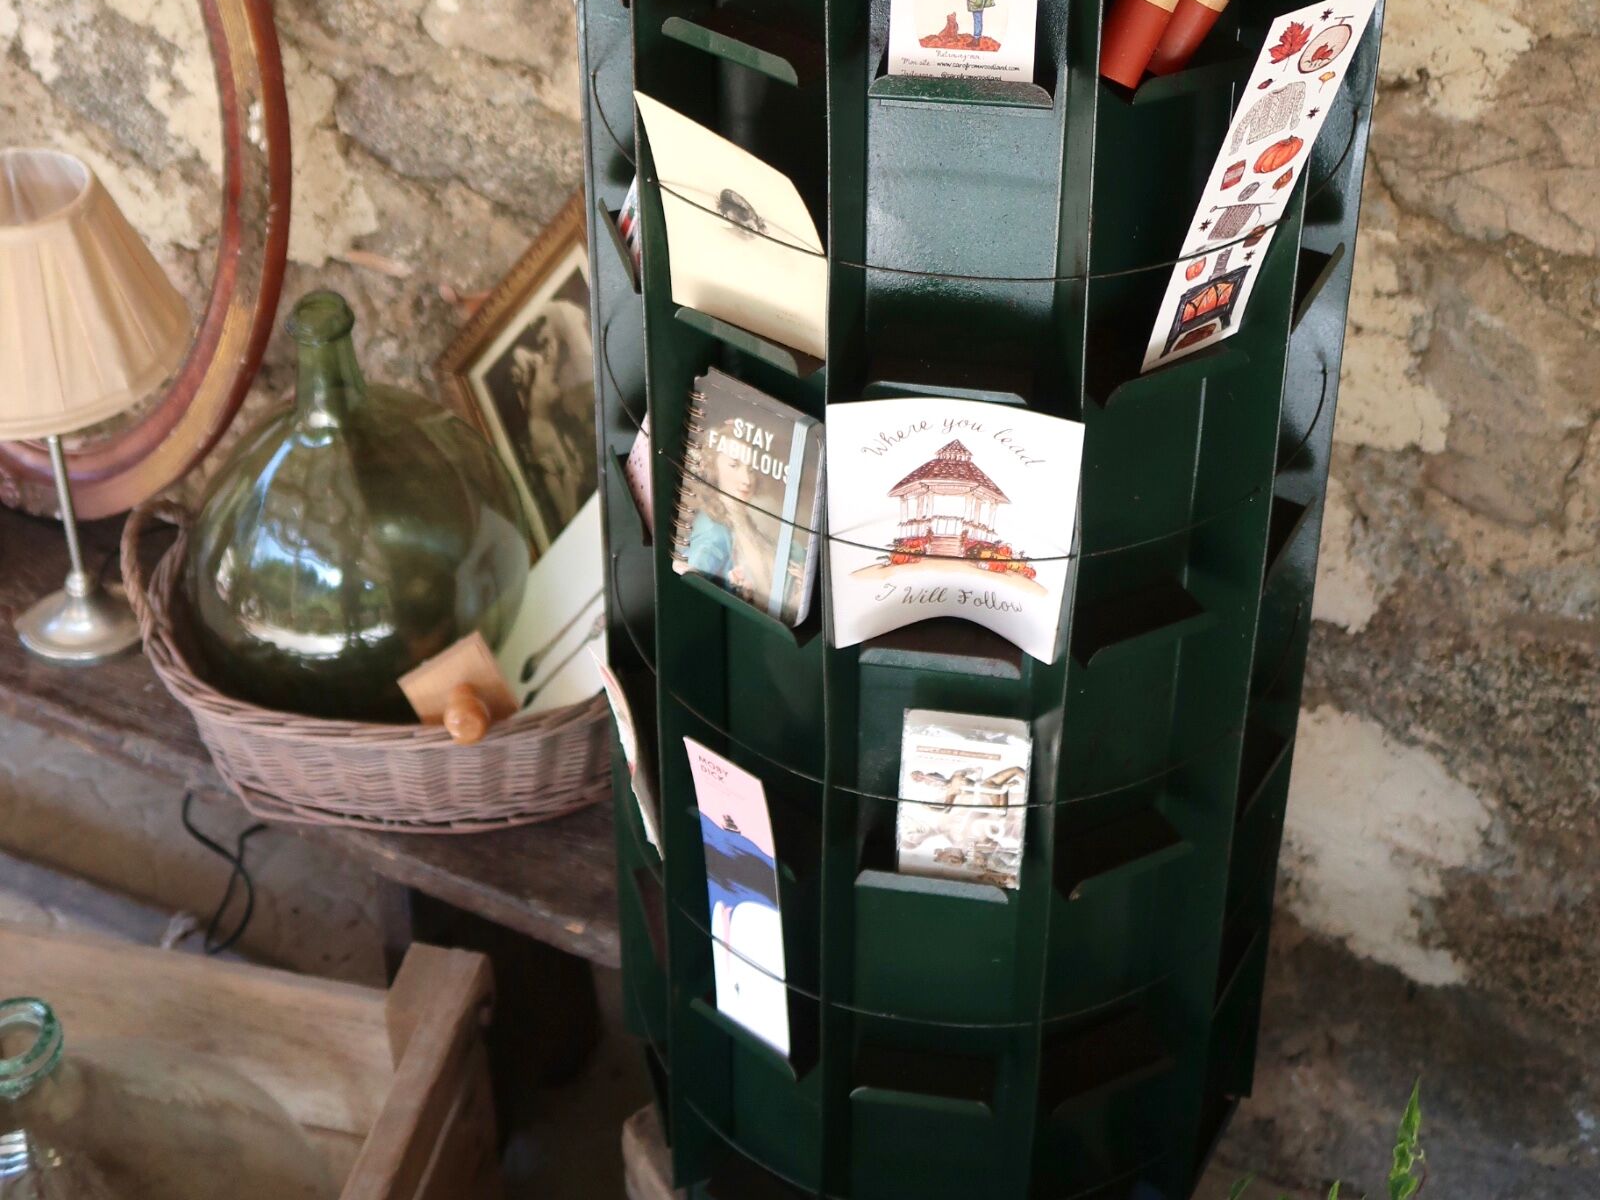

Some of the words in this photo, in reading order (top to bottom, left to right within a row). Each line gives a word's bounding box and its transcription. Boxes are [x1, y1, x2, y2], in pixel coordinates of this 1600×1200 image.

[733, 417, 774, 452] STAY
[861, 419, 934, 457] Where
[941, 417, 986, 434] you
[993, 428, 1046, 469] lead
[708, 430, 789, 485] FABULOUS
[901, 585, 949, 605] Will
[957, 589, 1023, 613] Follow
[699, 755, 728, 777] MOBY
[700, 764, 726, 784] DICK
